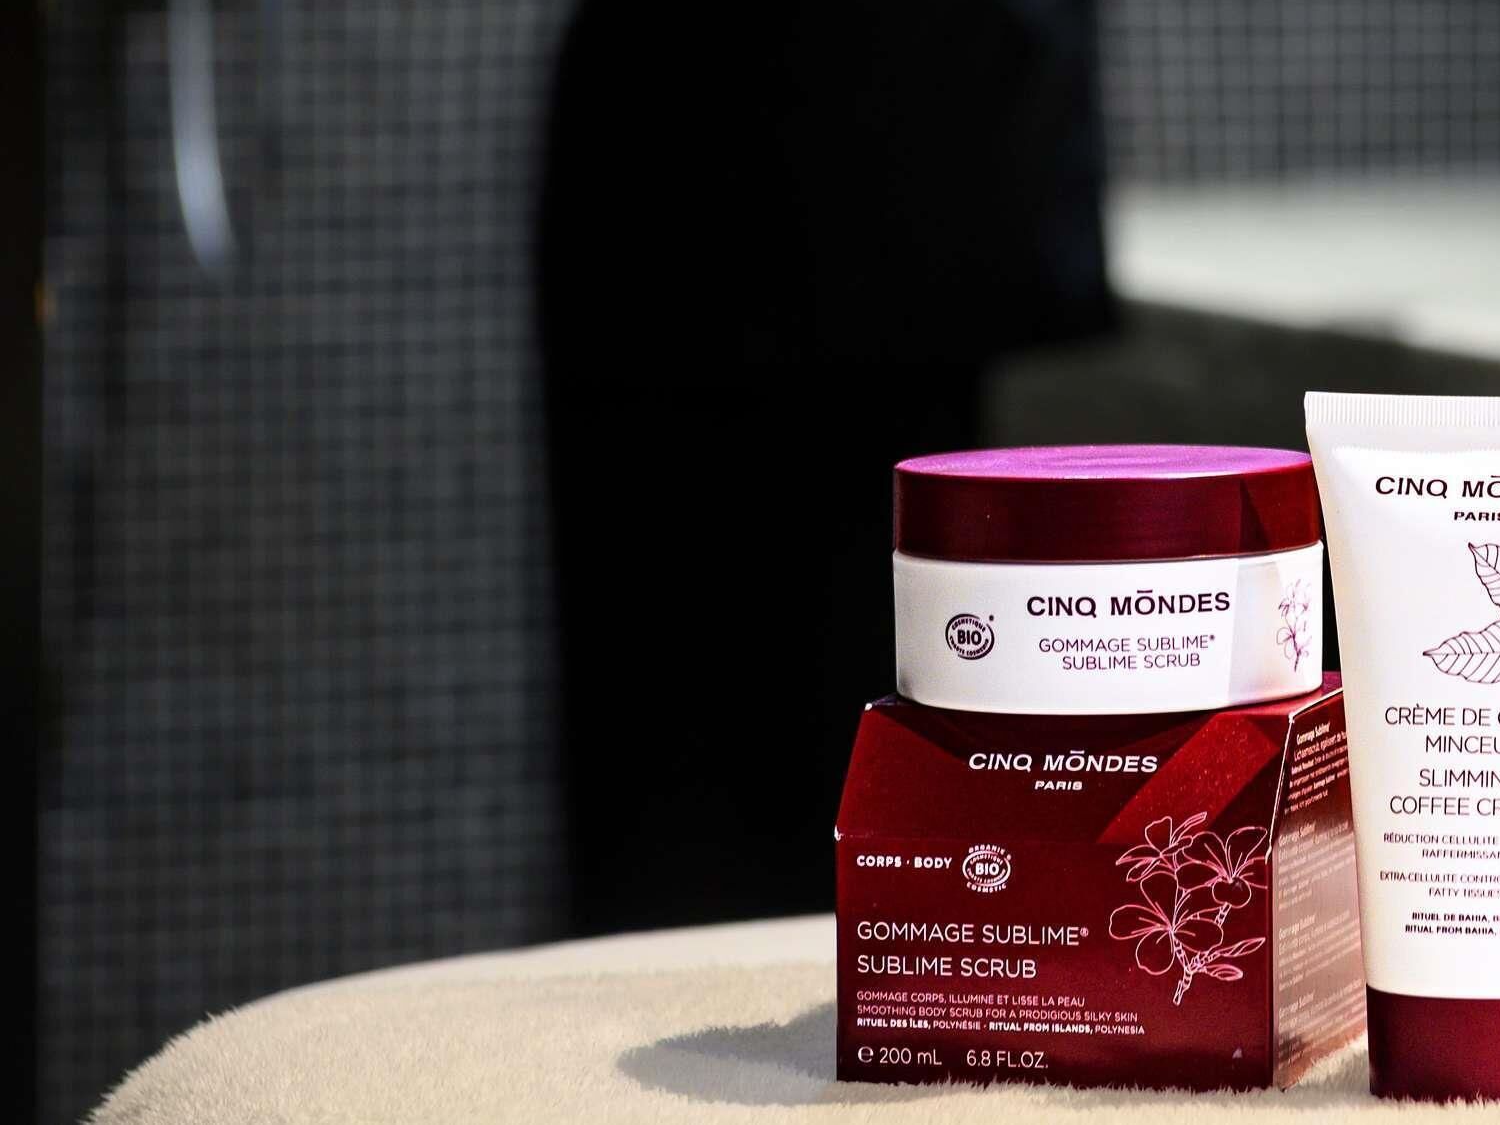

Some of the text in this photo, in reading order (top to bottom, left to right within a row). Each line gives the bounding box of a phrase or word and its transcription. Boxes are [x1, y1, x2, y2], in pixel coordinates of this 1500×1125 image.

[1375, 476, 1447, 498] CINQ
[1026, 595, 1097, 617] CINQ
[957, 629, 982, 646] BIO
[1038, 638, 1131, 654] GOMMAGE
[1062, 653, 1201, 671] SUBLIME SCRUB
[1384, 704, 1456, 726] CRÈME
[1462, 708, 1491, 727] DE
[968, 751, 1033, 773] CINQ
[1034, 779, 1083, 791] PARIS
[1389, 795, 1470, 817] COFFEE
[1383, 832, 1439, 845] RÉDUCTION
[1441, 835, 1498, 846] CELLULITE
[856, 855, 953, 870] CORPS BODY
[975, 861, 1000, 876] BIO
[1428, 887, 1460, 898] FATTY
[1411, 912, 1440, 922] RITUEL
[1443, 913, 1456, 923] DE
[1458, 913, 1491, 924] BAHIA,
[857, 920, 975, 944] GOMMAGE
[1405, 924, 1433, 935] RITUAL
[1436, 925, 1463, 935] FROM
[1465, 926, 1497, 937] BAHIA,
[857, 954, 1038, 979] SUBLIME SCRUB
[857, 991, 1086, 1007] GOMMAGE CORPS, ILLUMINE ET LISSE LA PEAU
[857, 1005, 1139, 1023] SMOOTHING BODY SCRUB FOR A PRODIGIOUS SILKY SKIN
[857, 1017, 1146, 1035] RITUEL DES ÎLES, POLYNÉSIE RITUAL FROM ISLANDS, POLYNESIA
[879, 1047, 912, 1065] 200
[917, 1048, 943, 1066] mL
[966, 1049, 991, 1067] 6.8
[996, 1050, 1050, 1069] FL.OZ.
